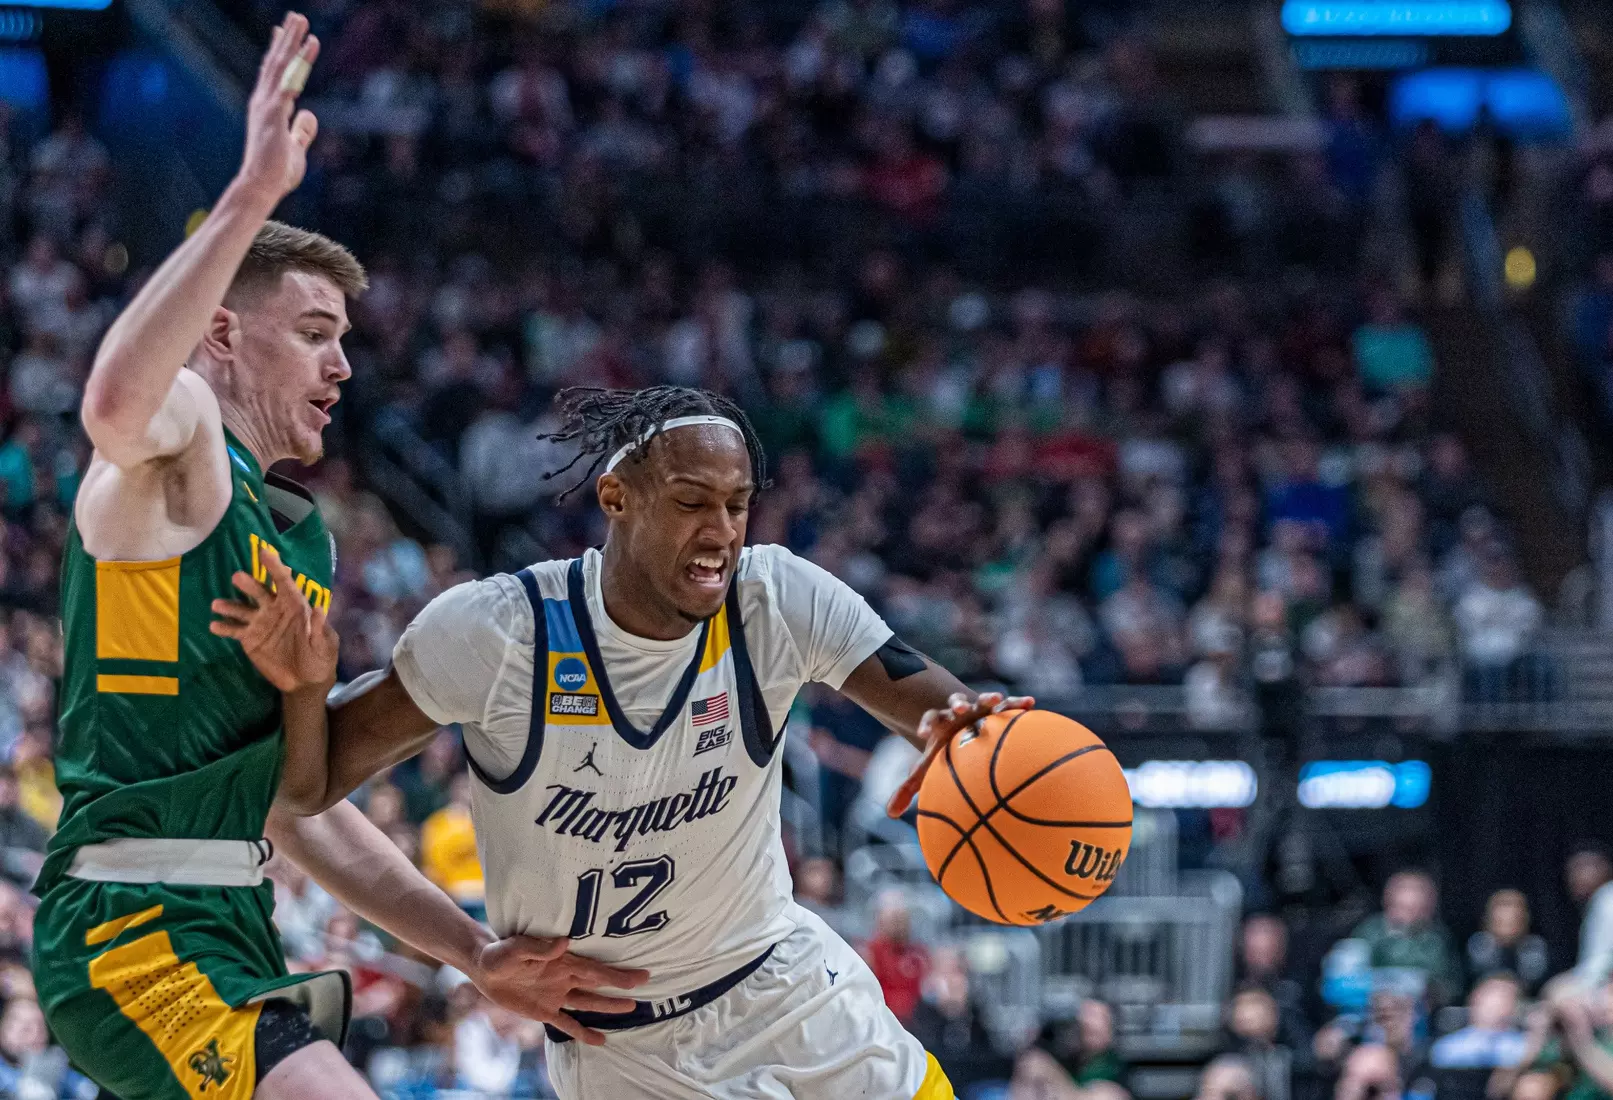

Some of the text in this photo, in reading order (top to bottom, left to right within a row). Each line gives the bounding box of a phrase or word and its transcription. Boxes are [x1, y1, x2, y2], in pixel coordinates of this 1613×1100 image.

[559, 673, 586, 682] NCAA
[551, 705, 596, 714] CHANGE
[695, 730, 732, 751] EAST
[699, 725, 725, 741] BIG
[534, 766, 738, 852] Marquette
[568, 854, 675, 940] 12
